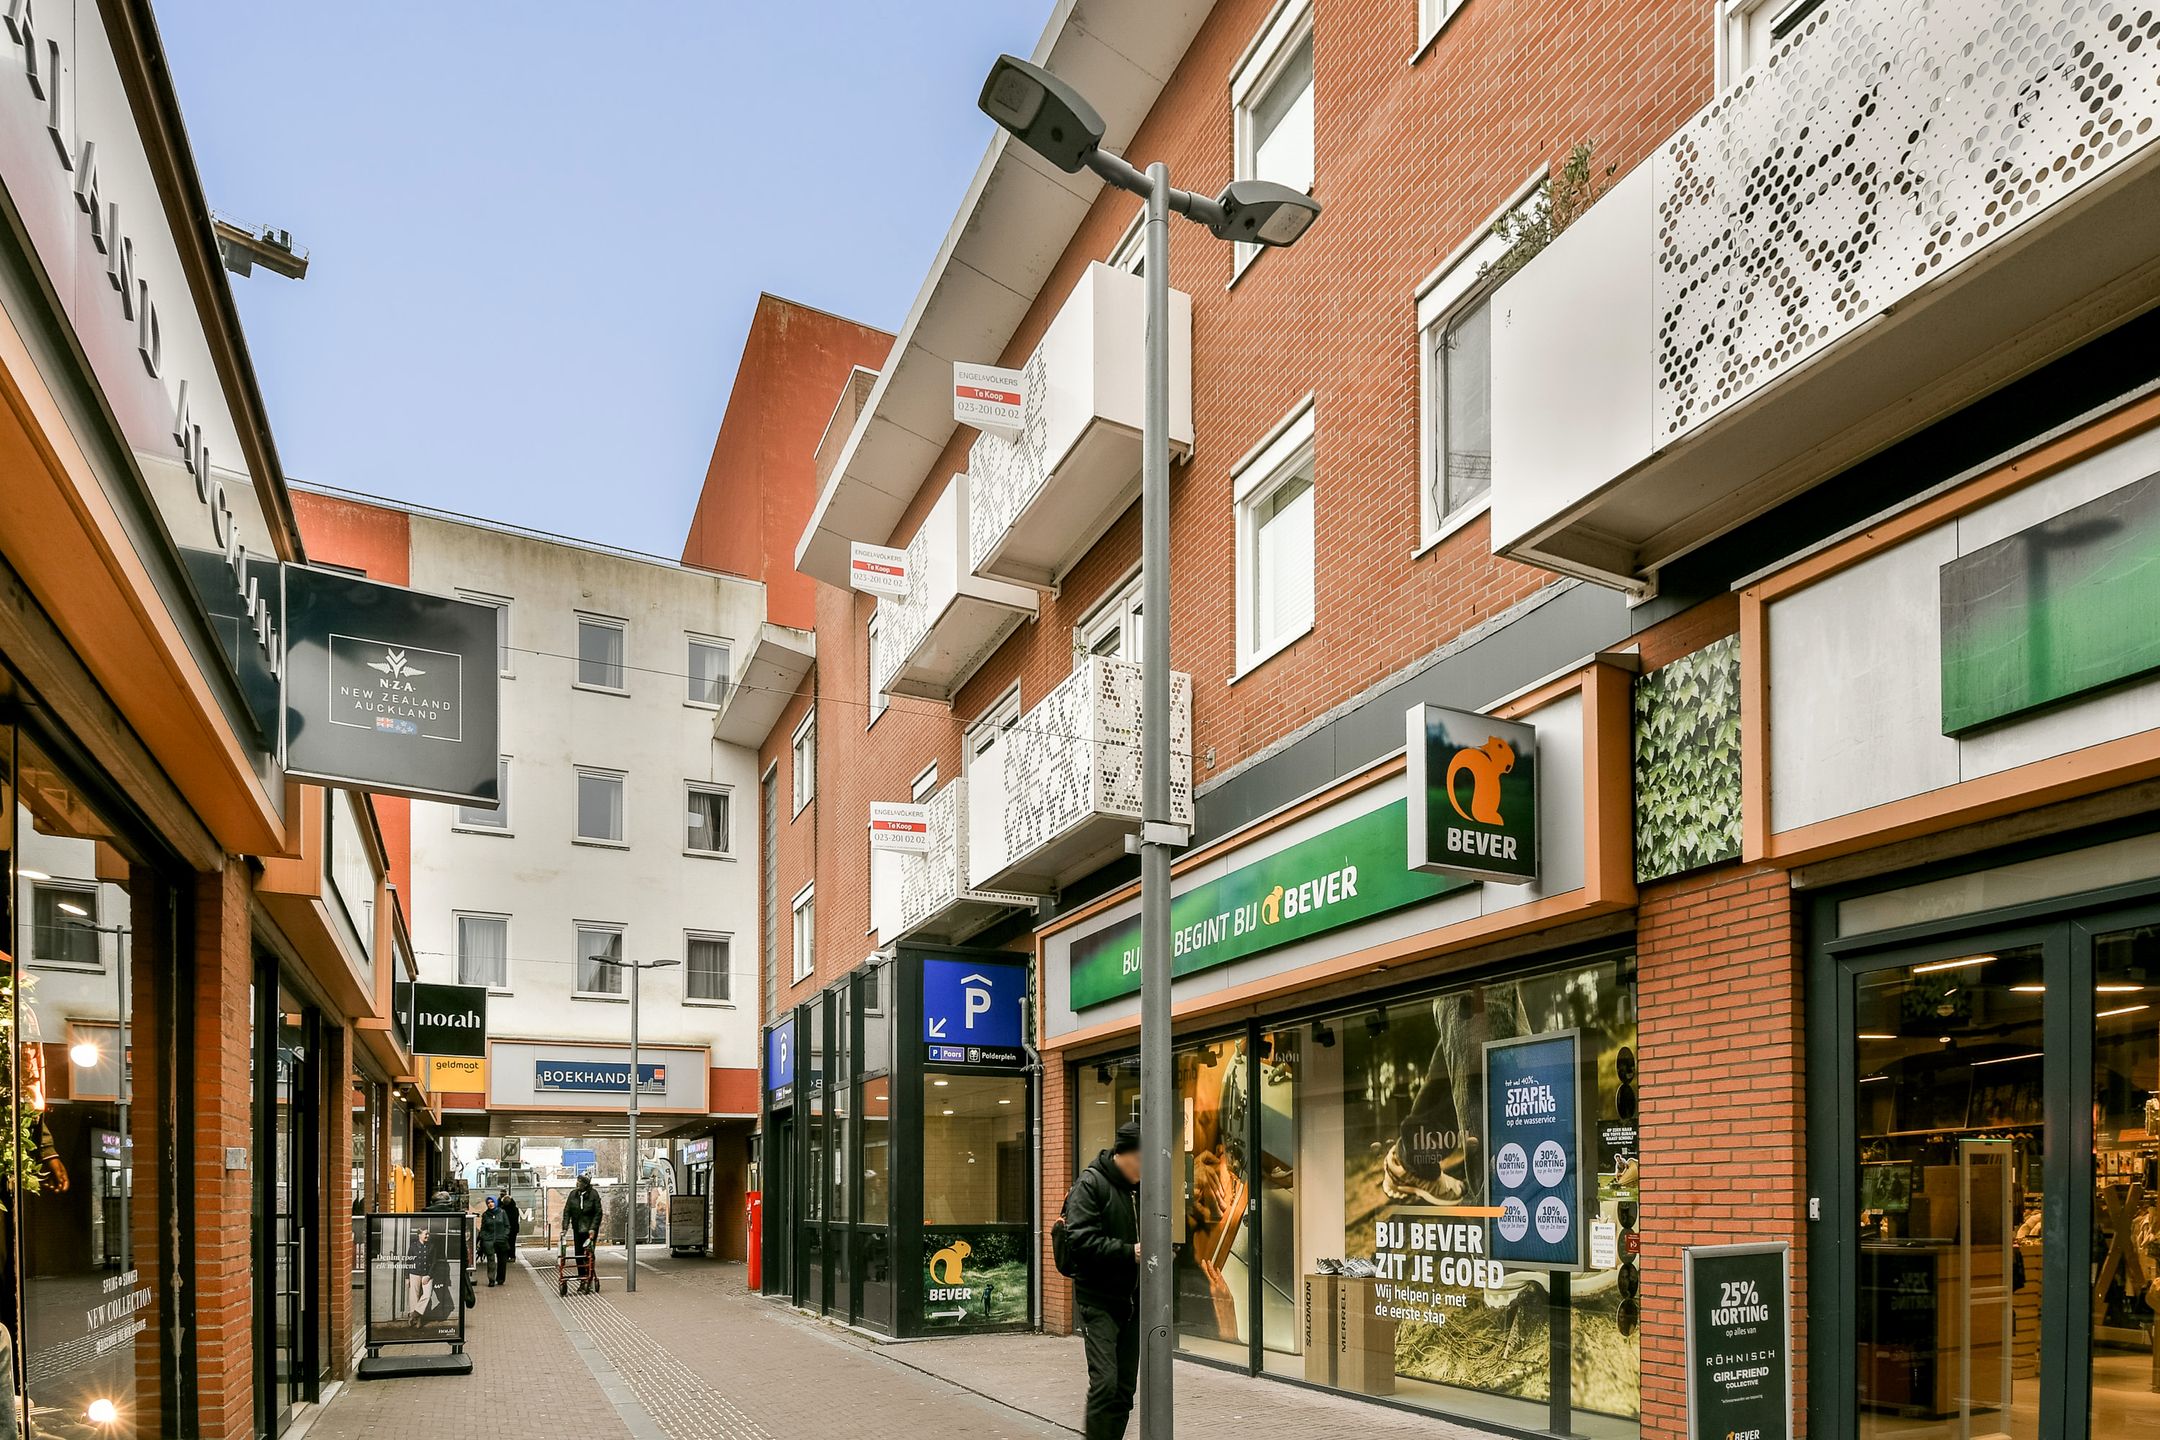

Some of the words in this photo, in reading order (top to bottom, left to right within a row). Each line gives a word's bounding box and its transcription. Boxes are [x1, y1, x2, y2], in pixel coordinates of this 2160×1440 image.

[974, 388, 984, 398] Te
[984, 389, 1004, 402] Koop
[957, 401, 993, 415] 023-201
[994, 407, 1006, 417] 02
[1008, 409, 1019, 419] 02
[173, 379, 283, 684] AUCKLAND
[874, 564, 891, 574] Koop
[853, 572, 881, 584] 023-201
[882, 578, 892, 586] 02
[340, 686, 374, 700] NEW
[382, 692, 451, 712] ZEALAND
[354, 701, 438, 721] AUCKLAND
[896, 823, 912, 831] Koop
[874, 832, 904, 842] 023-201
[905, 835, 914, 844] 02
[916, 836, 926, 844] 02
[1447, 827, 1518, 861] BEVER
[1174, 912, 1230, 957] BEGINT
[1233, 902, 1258, 938] BIJ
[1283, 865, 1358, 920] BEVER
[965, 987, 992, 1029] P
[419, 1010, 481, 1029] norah
[780, 1043, 787, 1075] P
[981, 1052, 1017, 1062] Polderplein
[436, 1060, 479, 1071] geldmaat
[1521, 1075, 1534, 1085] 40%
[1507, 1085, 1554, 1104] STAPEL
[1505, 1099, 1556, 1118] KORTING
[1506, 1119, 1514, 1128] op
[1515, 1118, 1523, 1126] de
[1524, 1115, 1556, 1125] wasservice
[1503, 1153, 1520, 1162] 40%
[1540, 1150, 1558, 1160] 30%
[1499, 1162, 1525, 1170] KORTING
[1534, 1159, 1565, 1168] KORTING
[1504, 1206, 1520, 1215] 20%
[1542, 1206, 1560, 1216] 10%
[1537, 1215, 1567, 1224] KORTING
[1375, 1221, 1404, 1249] BIJ
[1410, 1222, 1484, 1254] BEVER
[1375, 1252, 1407, 1280] ZIT
[1411, 1255, 1434, 1283] JE
[1440, 1256, 1504, 1290] GOED
[929, 1287, 972, 1301] BEVER
[1375, 1283, 1392, 1302] Wij
[1394, 1284, 1429, 1305] helpen
[1431, 1289, 1442, 1308] je
[1444, 1294, 1467, 1308] met
[1720, 1280, 1759, 1307] 25%
[87, 1304, 106, 1332] NEW
[107, 1286, 152, 1322] COLLECTION
[1375, 1301, 1388, 1317] de
[1390, 1306, 1421, 1321] eerste
[1423, 1309, 1446, 1328] stap
[1711, 1304, 1769, 1326] KORTING
[1725, 1330, 1734, 1338] op
[1734, 1327, 1747, 1336] alles
[1706, 1349, 1776, 1367] RÖHNISCH
[1713, 1366, 1770, 1383] GIRLFRIEND
[1725, 1378, 1759, 1390] COLLECTIVE
[1734, 1429, 1760, 1440] BEVER
